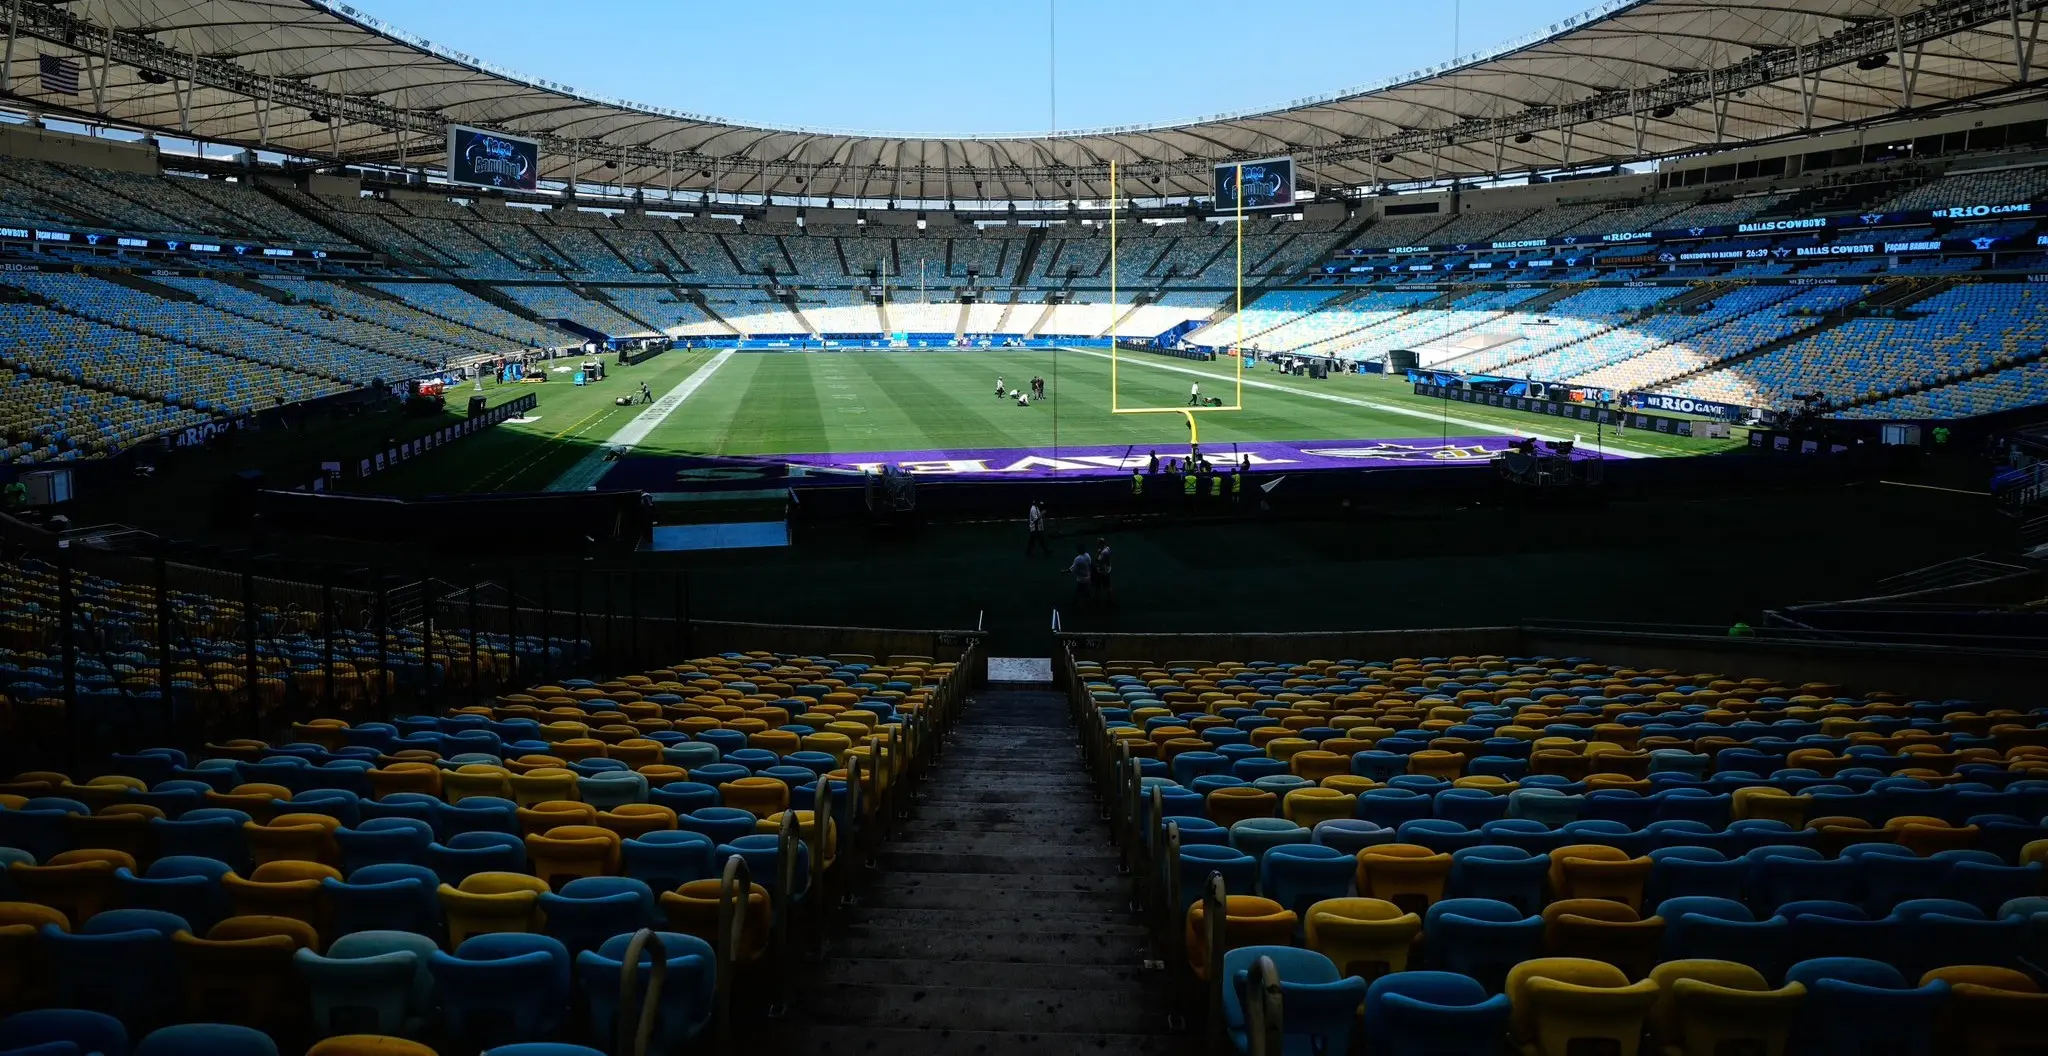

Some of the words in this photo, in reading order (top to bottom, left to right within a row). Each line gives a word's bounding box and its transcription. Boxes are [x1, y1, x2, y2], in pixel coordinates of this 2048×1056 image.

[1932, 209, 1948, 218] NFL
[1991, 203, 2031, 214] GAME
[1738, 222, 1776, 232] DALLAS
[1776, 218, 1826, 230] COWBOYS
[1632, 231, 1652, 239] GAME
[1492, 241, 1517, 249] DALLAS
[1517, 239, 1547, 248] COWBOYS
[1796, 246, 1830, 256] DALLAS
[1831, 244, 1874, 254] COWBOYS
[1680, 252, 1711, 260] COUNTDOWN
[1746, 249, 1769, 258] 26:39
[1647, 396, 1660, 406] NFL
[1694, 403, 1725, 415] GAME
